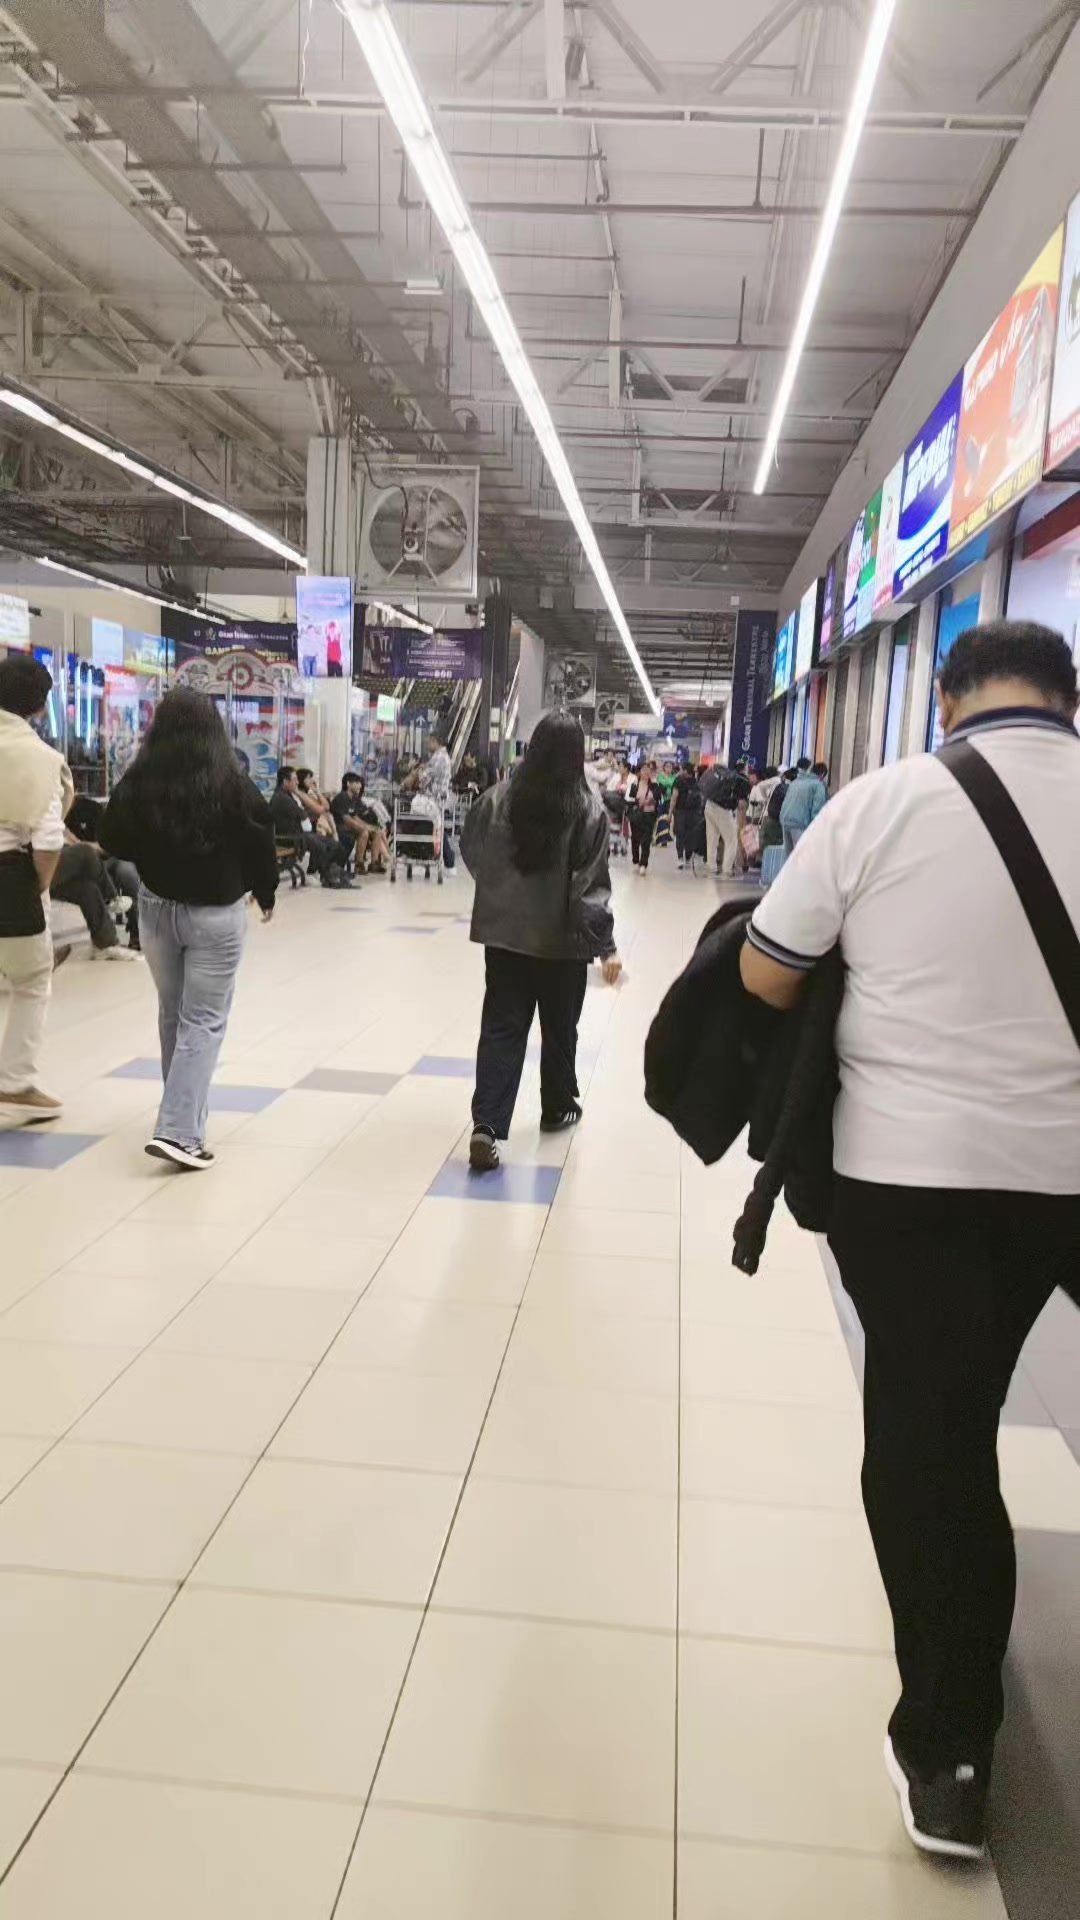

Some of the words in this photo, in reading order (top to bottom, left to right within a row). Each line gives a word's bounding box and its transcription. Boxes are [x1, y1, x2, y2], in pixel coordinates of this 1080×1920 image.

[747, 625, 759, 676] TERRESTRE
[744, 679, 755, 724] TERMINAL
[742, 725, 751, 751] GRAN
